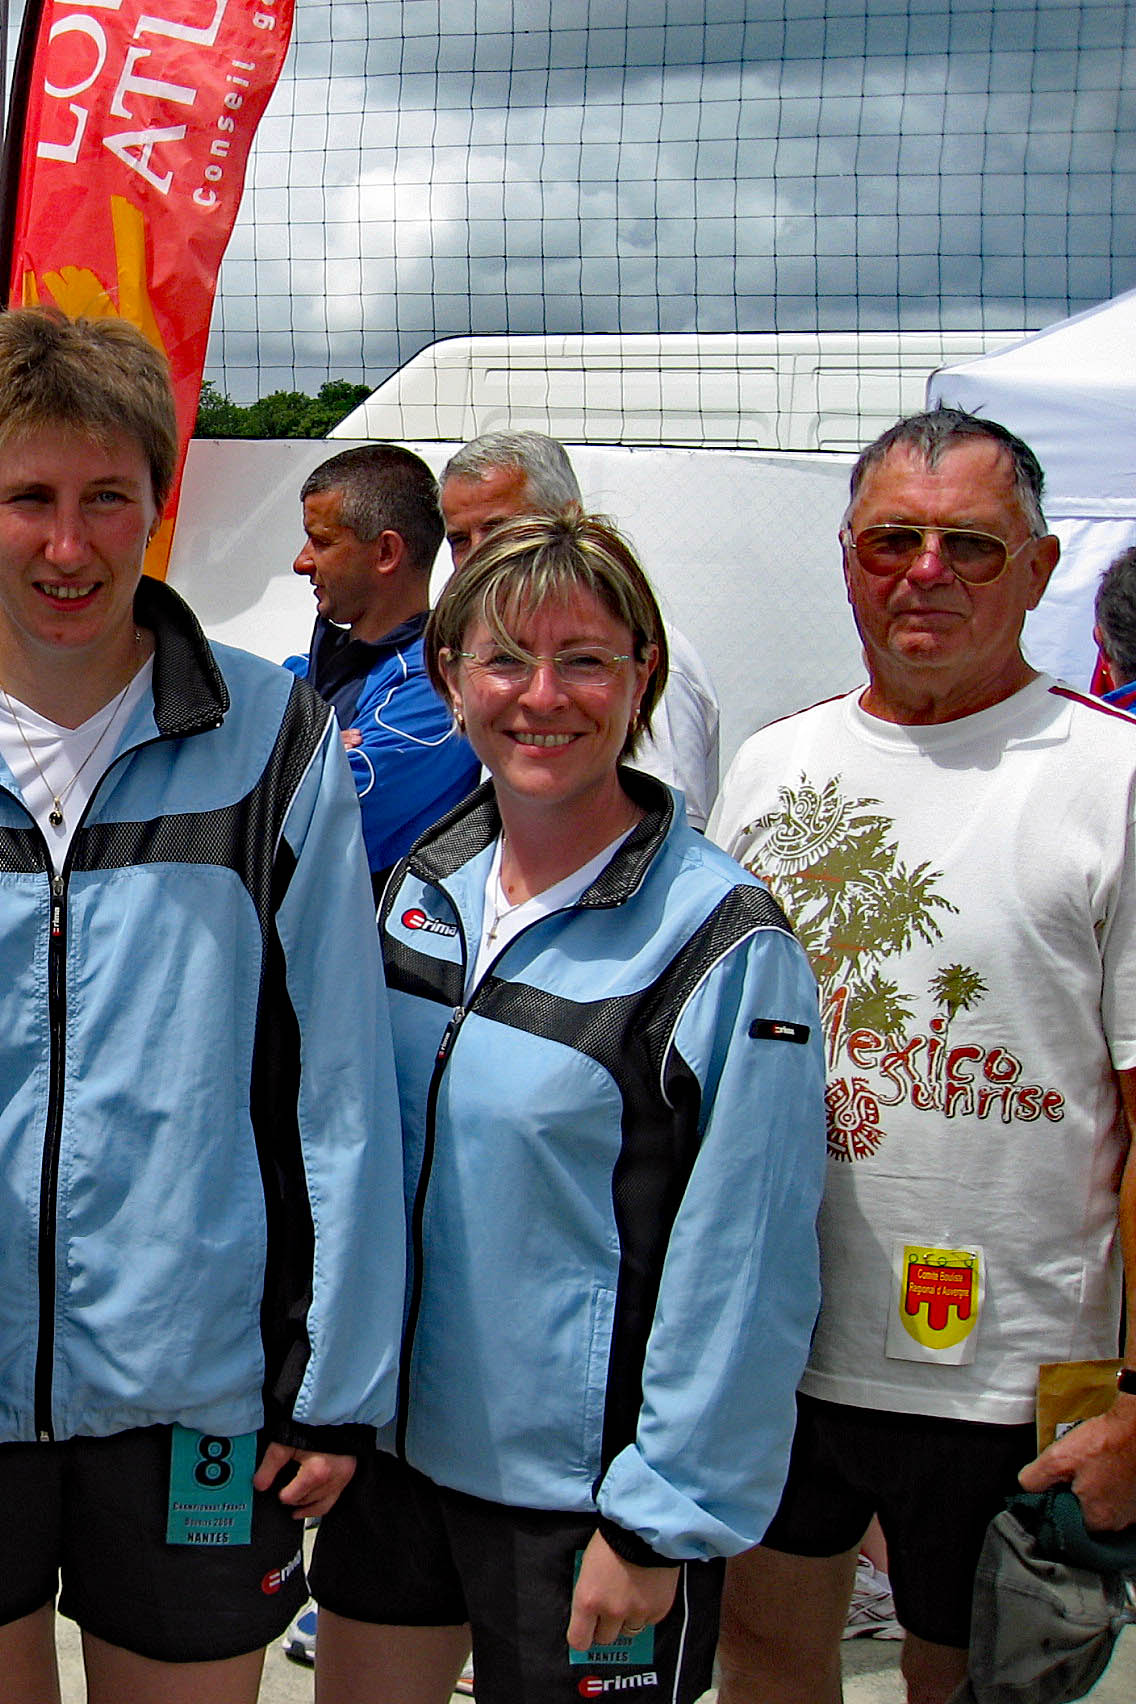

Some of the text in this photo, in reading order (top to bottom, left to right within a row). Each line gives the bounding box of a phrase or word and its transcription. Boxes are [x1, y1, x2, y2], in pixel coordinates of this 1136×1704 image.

[193, 60, 256, 207] Conseil
[193, 1436, 234, 1489] 8
[187, 1531, 230, 1544] NANTES
[587, 1651, 629, 1663] NANTES
